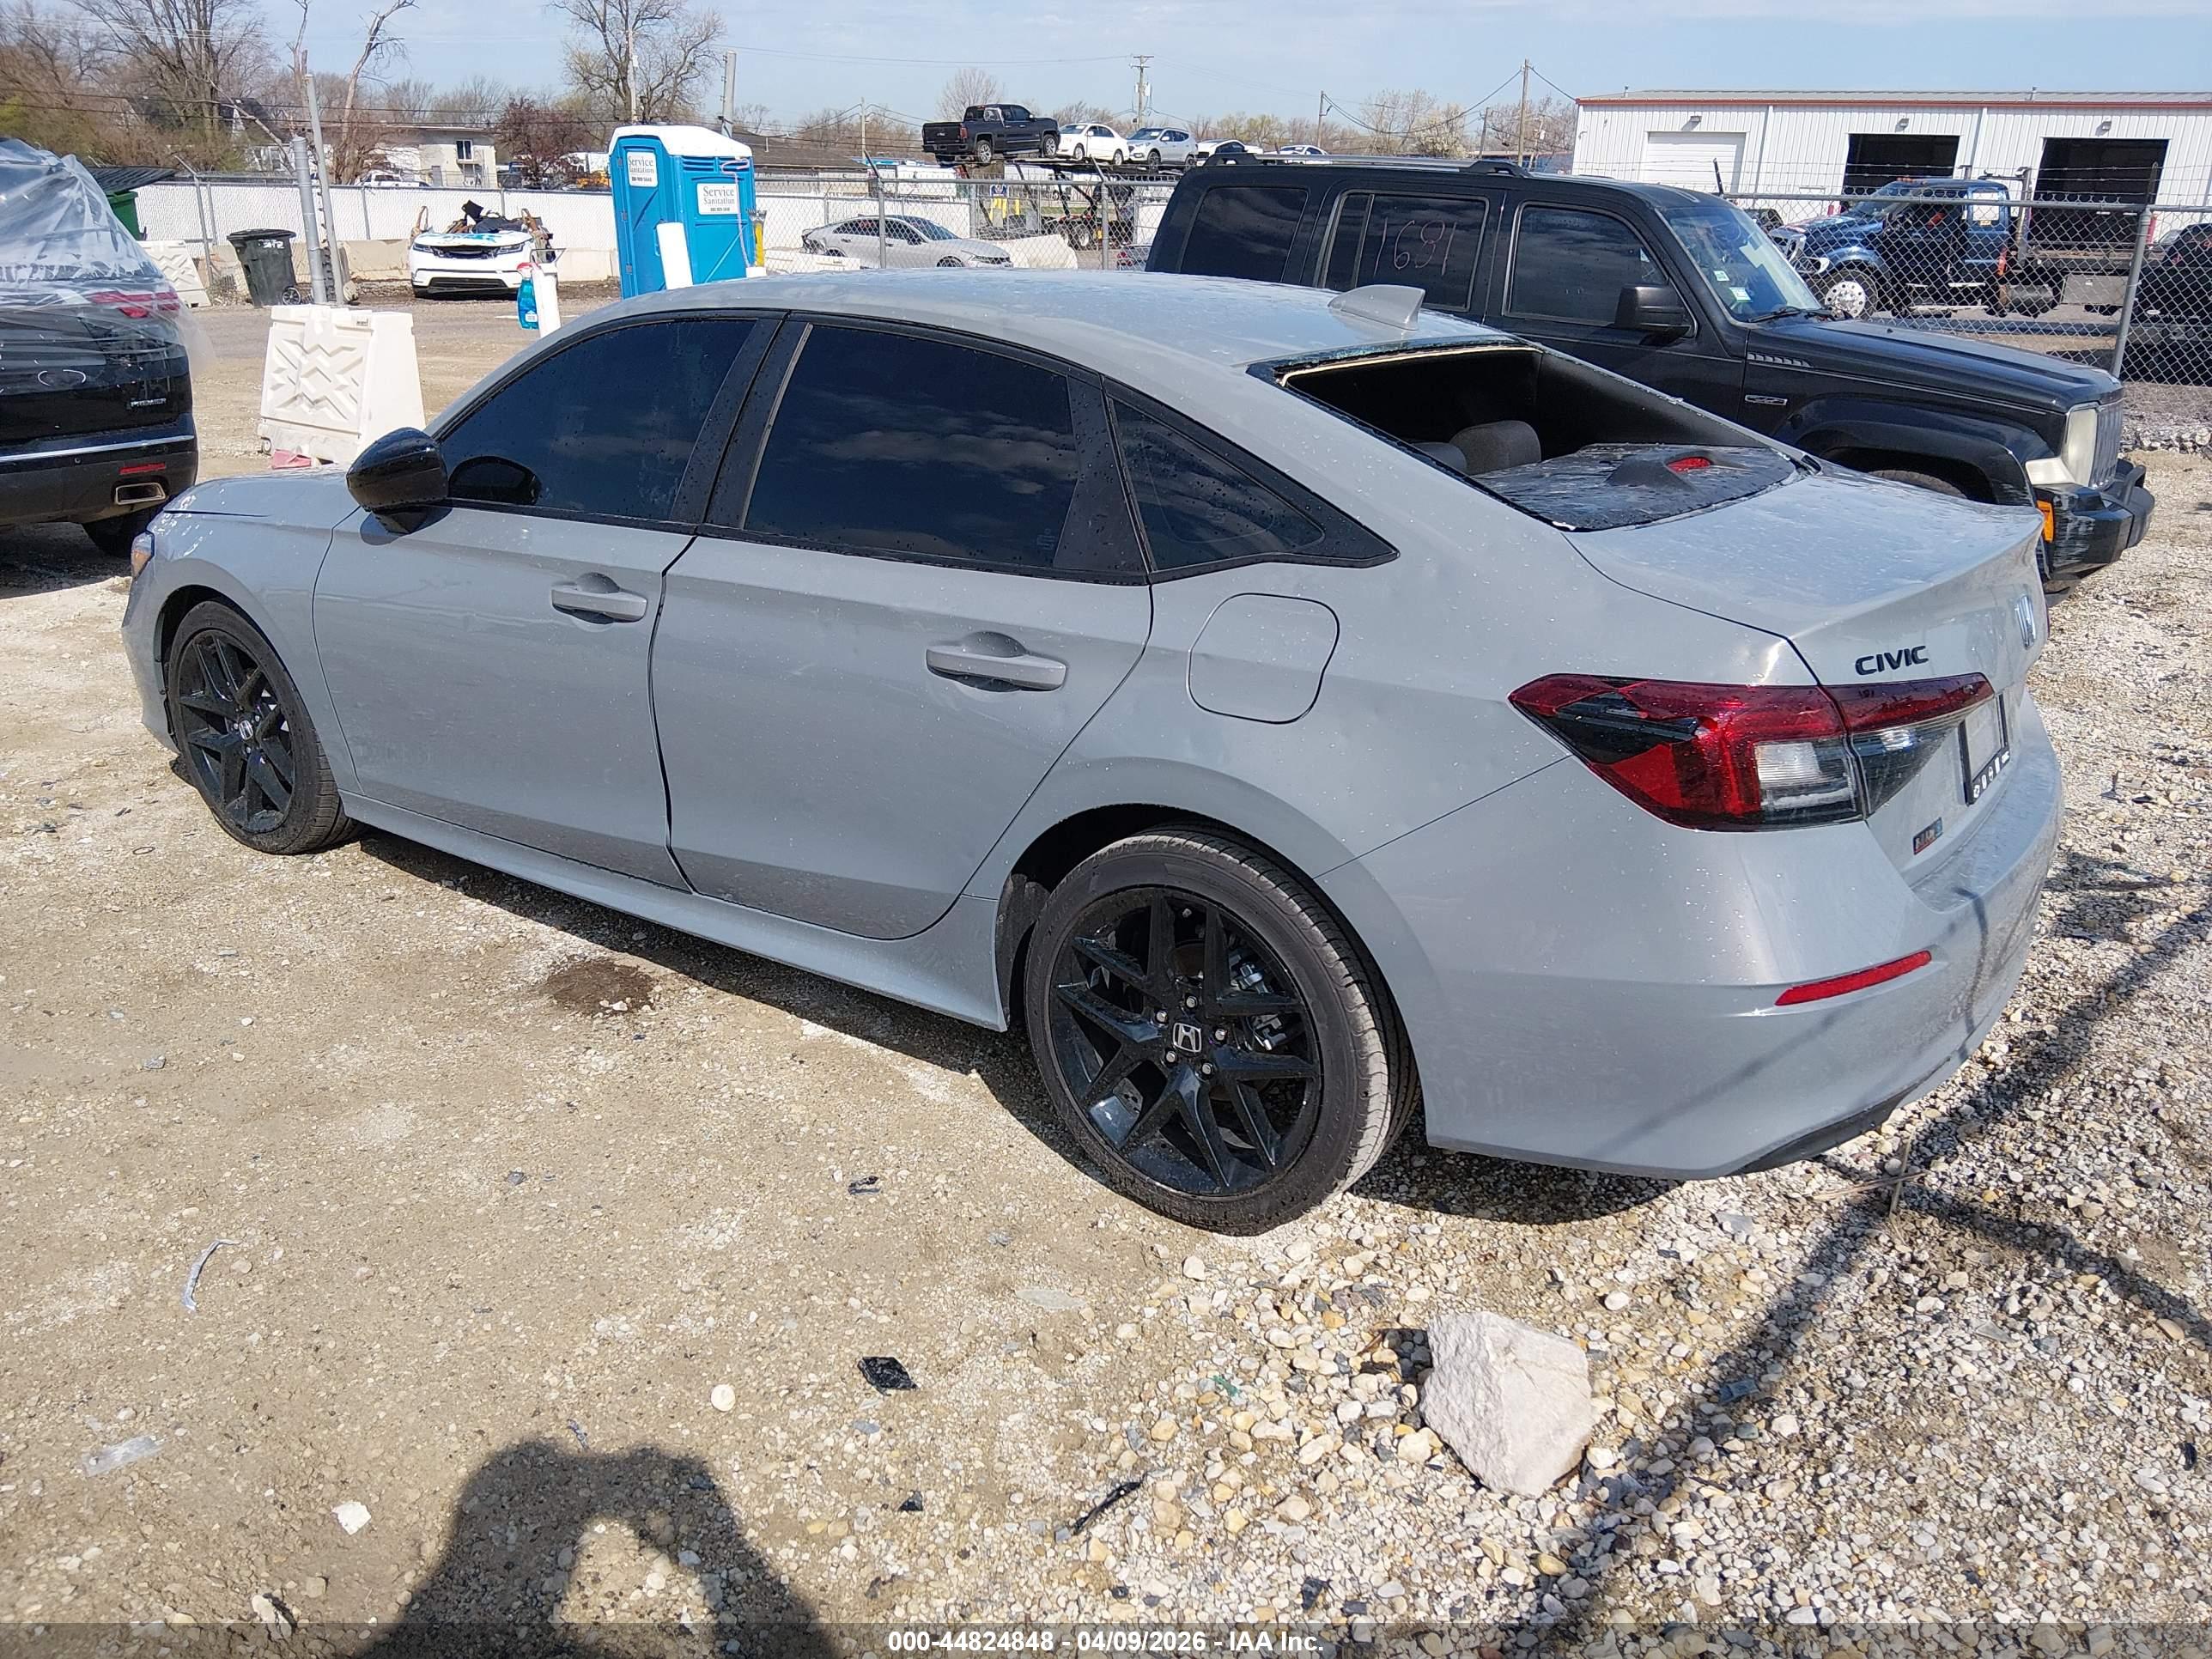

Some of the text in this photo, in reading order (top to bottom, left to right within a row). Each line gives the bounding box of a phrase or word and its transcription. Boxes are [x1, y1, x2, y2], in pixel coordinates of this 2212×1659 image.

[628, 155, 654, 167] Service
[702, 185, 735, 197] Service
[703, 197, 735, 205] Sanitation
[1855, 646, 1929, 675] CIVIC
